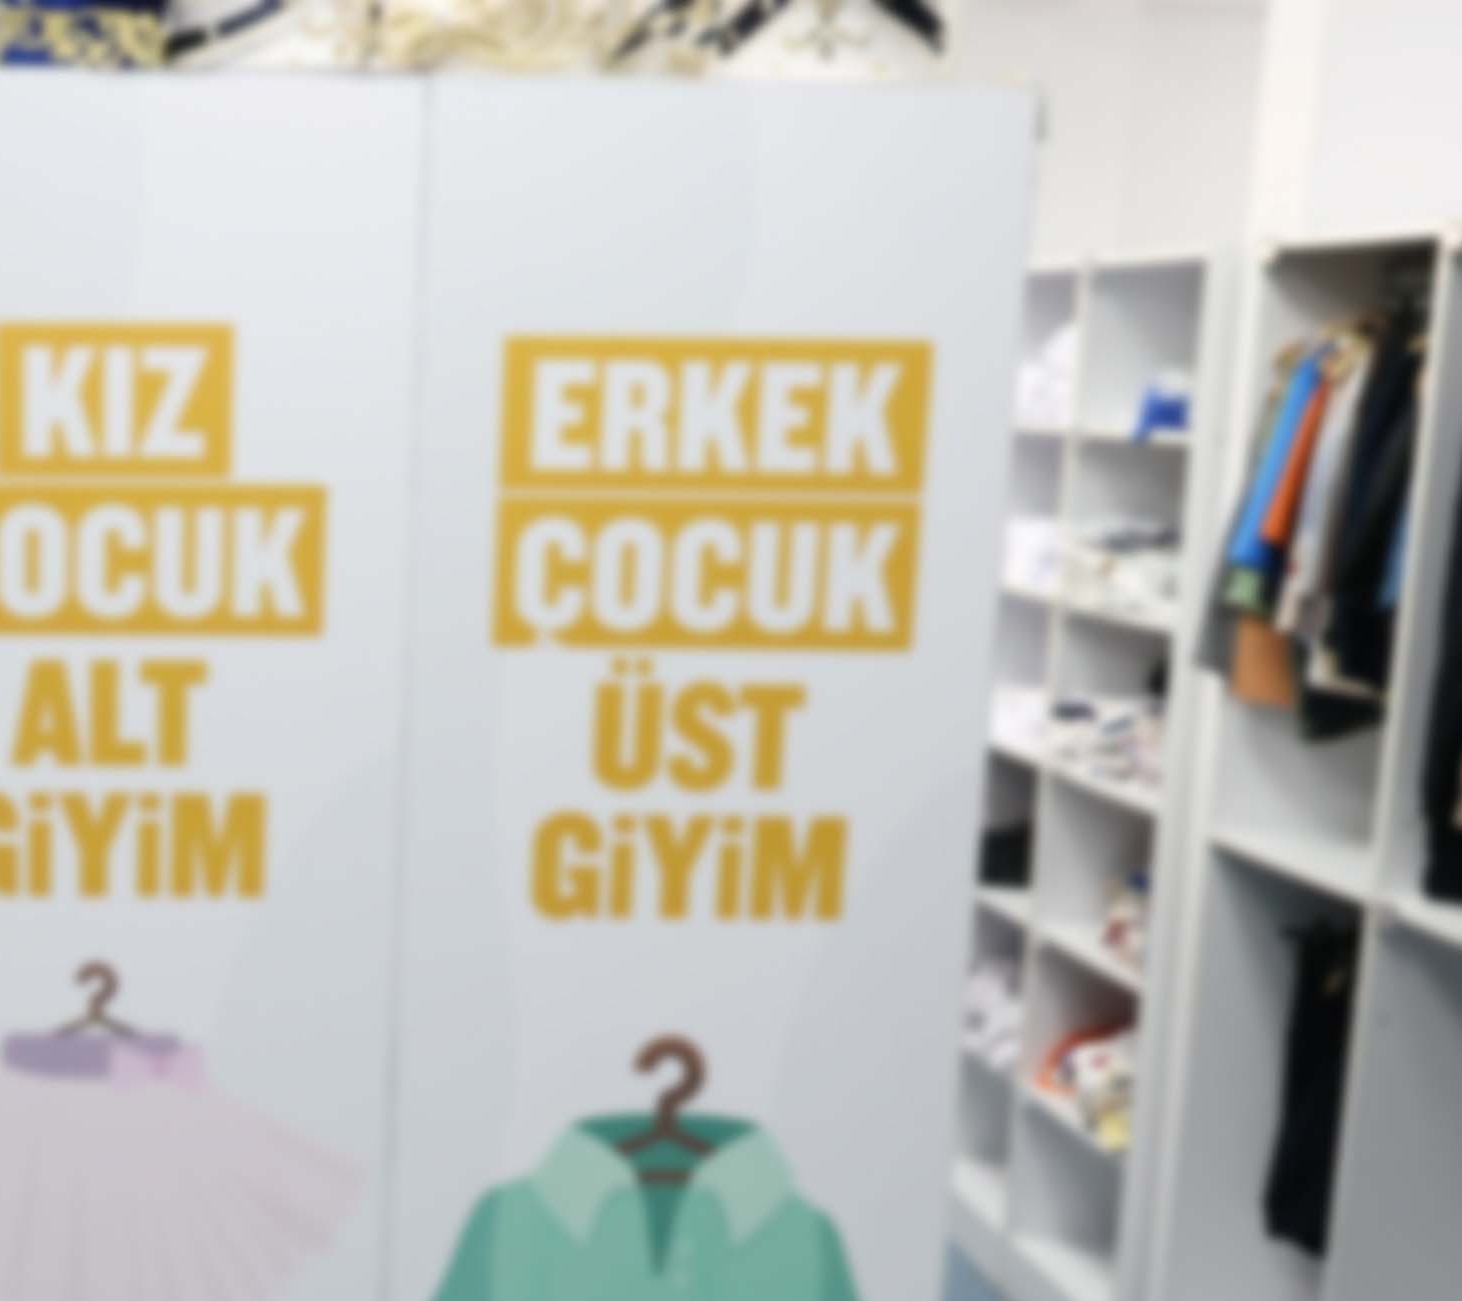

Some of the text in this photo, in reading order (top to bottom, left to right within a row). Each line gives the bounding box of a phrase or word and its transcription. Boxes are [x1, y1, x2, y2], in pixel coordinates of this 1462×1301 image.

[20, 344, 210, 457] KIZ
[529, 356, 904, 476] ERKEK
[514, 515, 900, 645] ÇOCUK
[10, 659, 209, 768] ALT
[591, 657, 807, 792] ÜST
